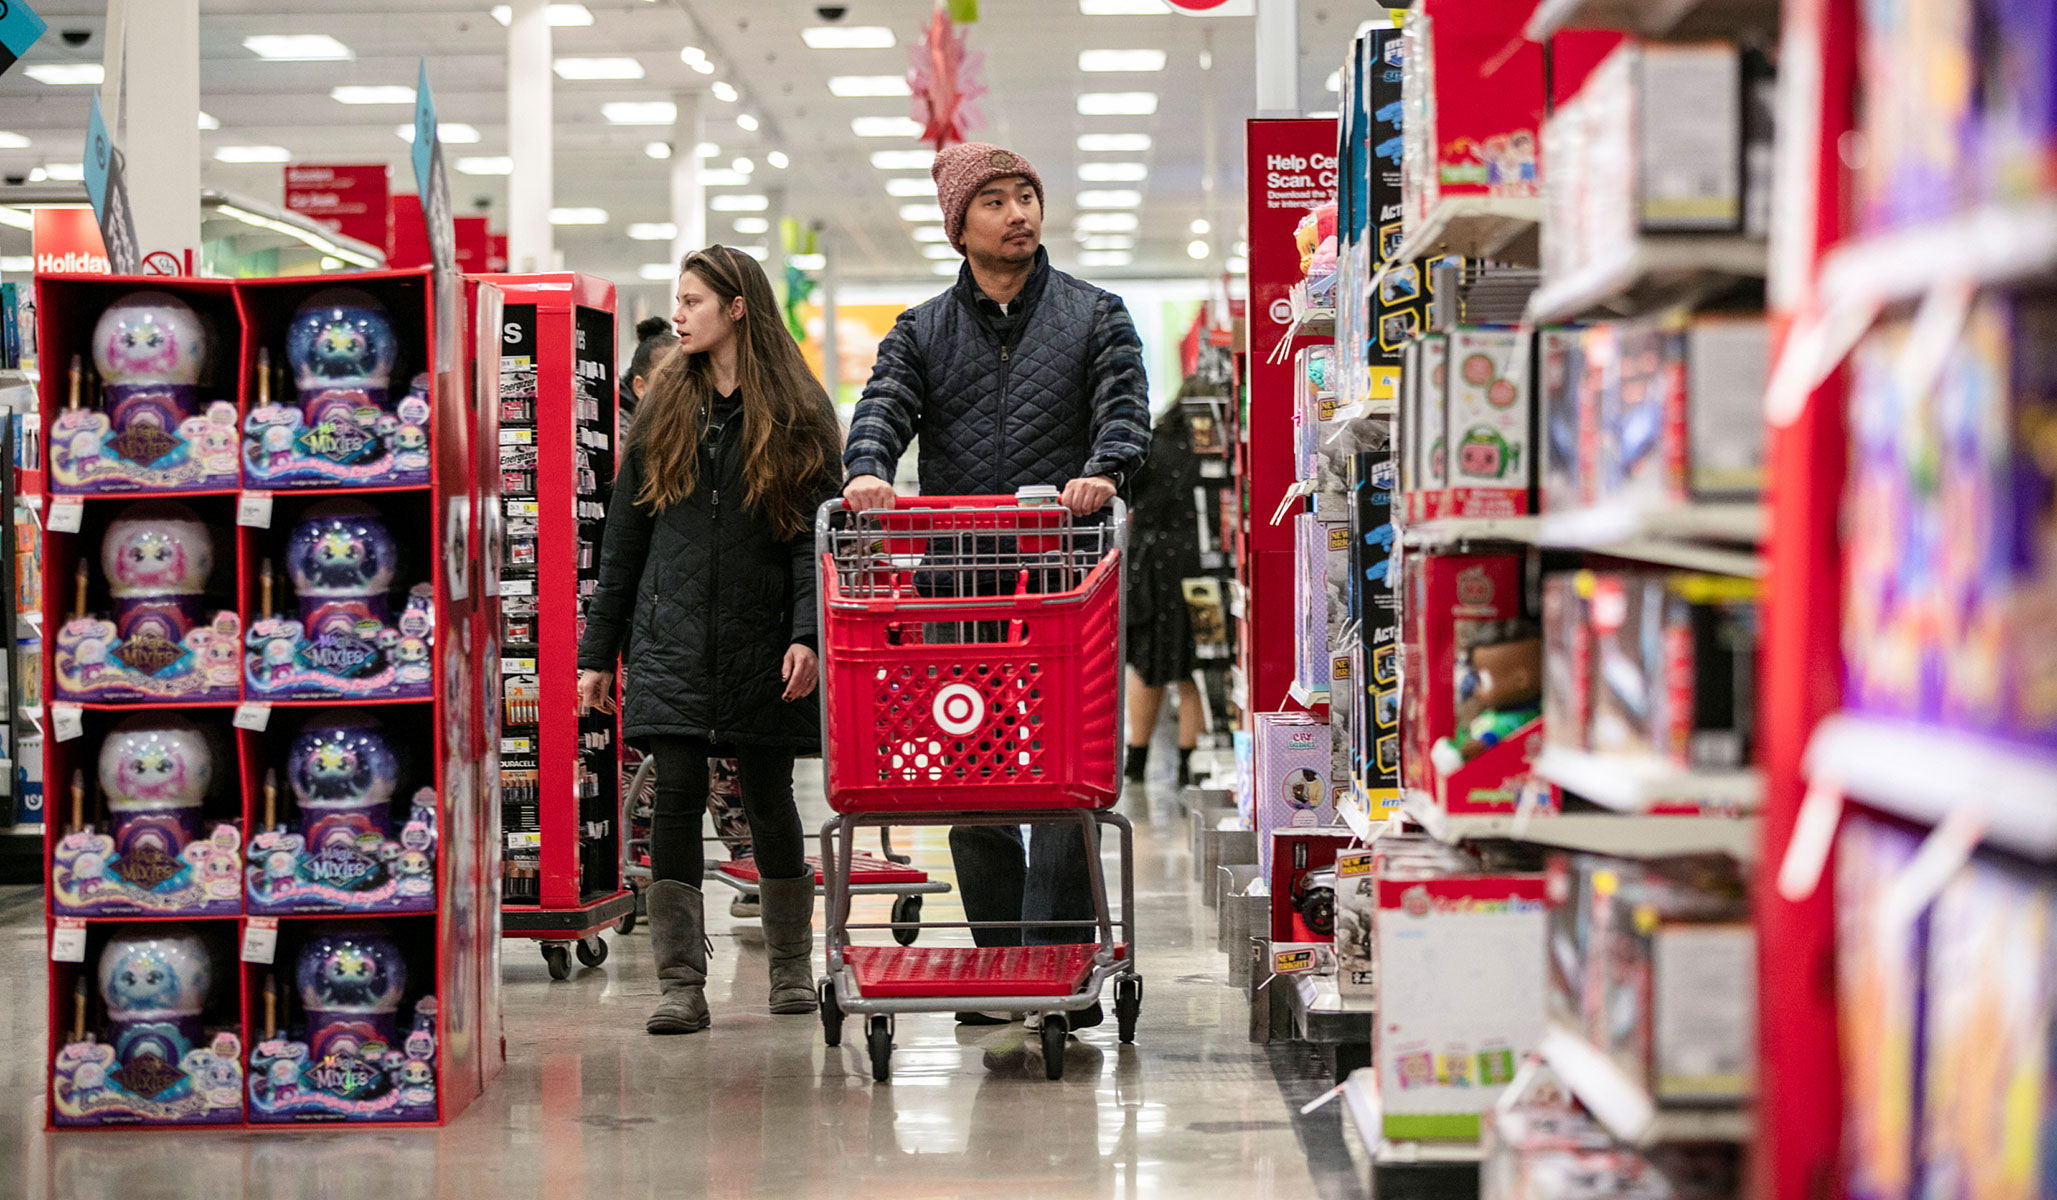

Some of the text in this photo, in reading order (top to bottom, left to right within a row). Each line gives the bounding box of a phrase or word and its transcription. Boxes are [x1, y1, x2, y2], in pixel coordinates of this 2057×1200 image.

[1267, 154, 1308, 173] Help
[1267, 172, 1316, 188] Scan.
[1267, 190, 1311, 199] Download
[1311, 190, 1327, 198] the
[1267, 200, 1280, 208] for
[1380, 204, 1403, 222] ACT
[38, 252, 112, 275] Holiday
[500, 378, 536, 394] Energizer
[500, 451, 536, 466] Energizer
[1373, 626, 1396, 644] ACT
